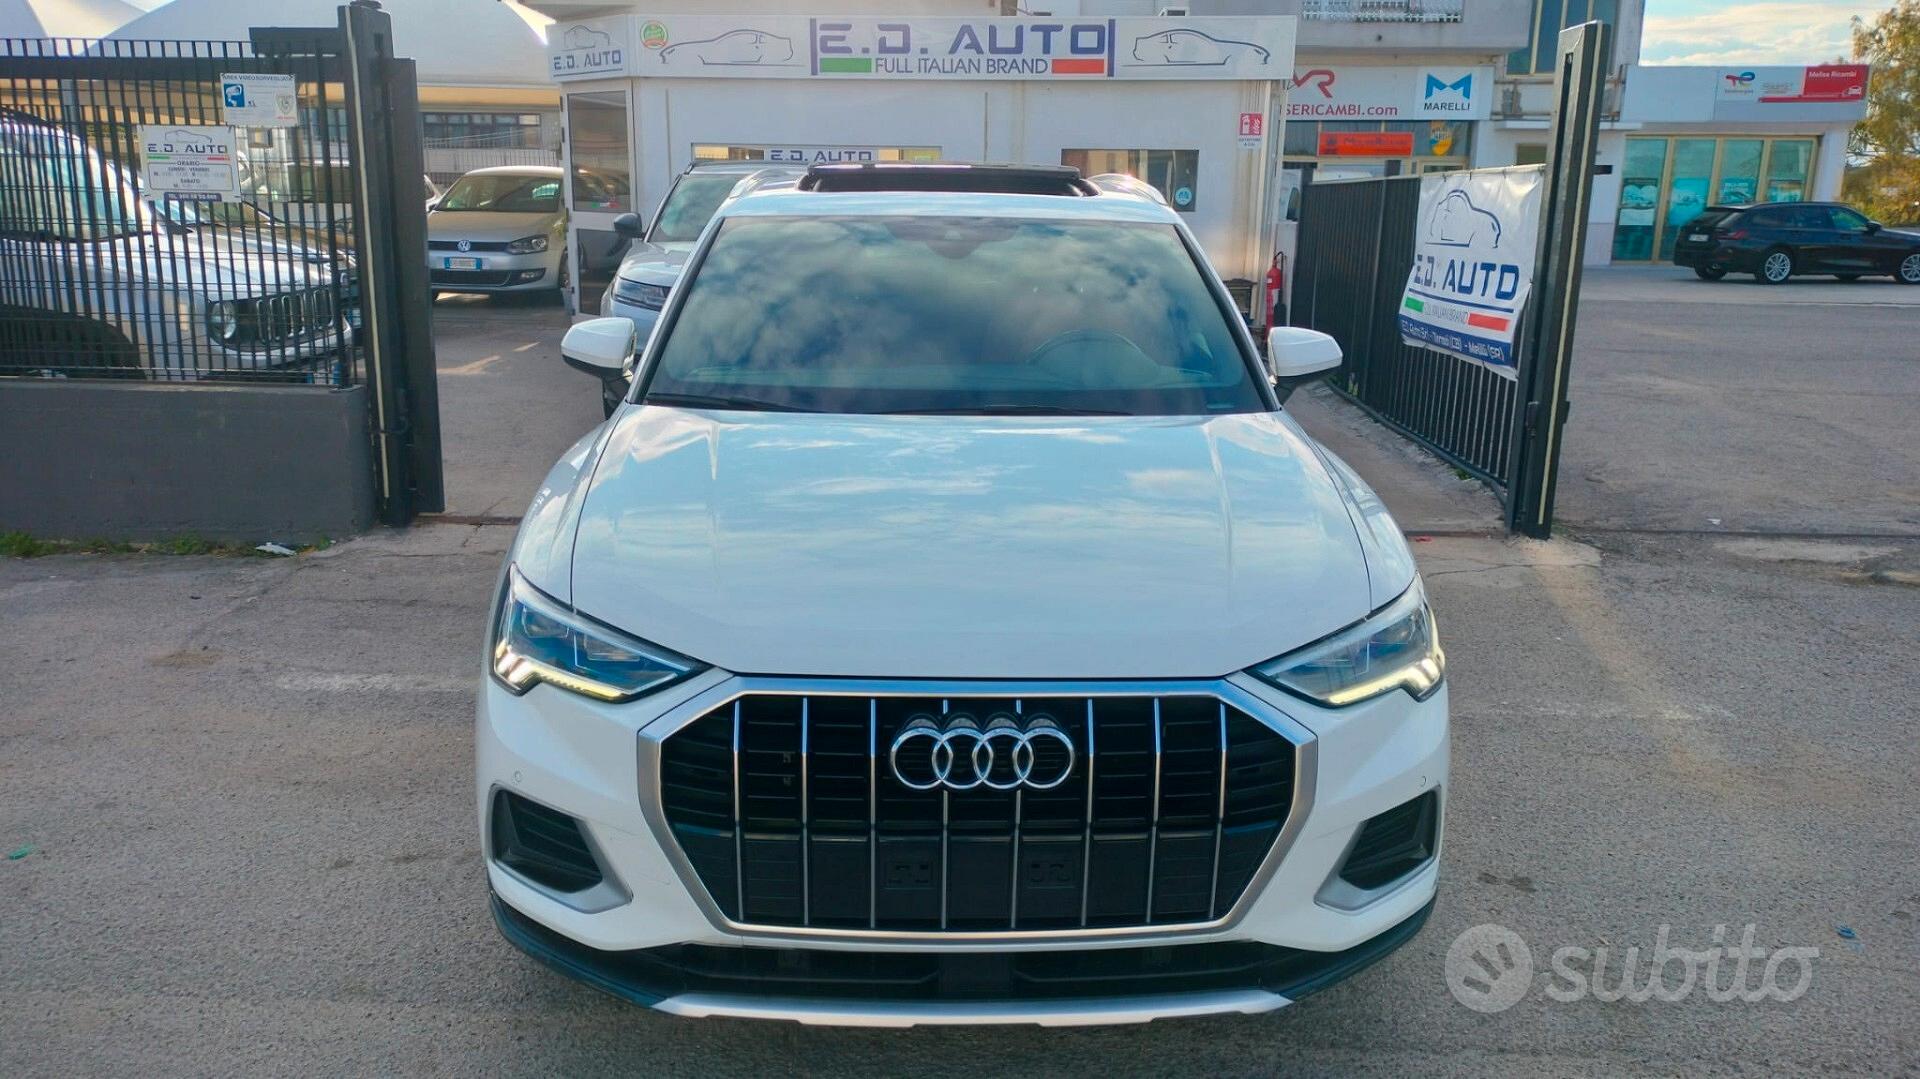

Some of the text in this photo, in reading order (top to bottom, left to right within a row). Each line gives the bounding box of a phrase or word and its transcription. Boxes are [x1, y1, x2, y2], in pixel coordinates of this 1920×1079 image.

[818, 24, 1107, 56] E.D. AUTO
[553, 49, 622, 71] E.D. AUTO
[874, 57, 1049, 74] FULL ITALIAN BRAND
[1284, 103, 1399, 116] SERICAMBI.com
[1423, 102, 1471, 112] MARELLI
[147, 143, 228, 154] E.D. AUTO
[813, 150, 873, 163] AUTO
[1441, 257, 1520, 301] AUTO
